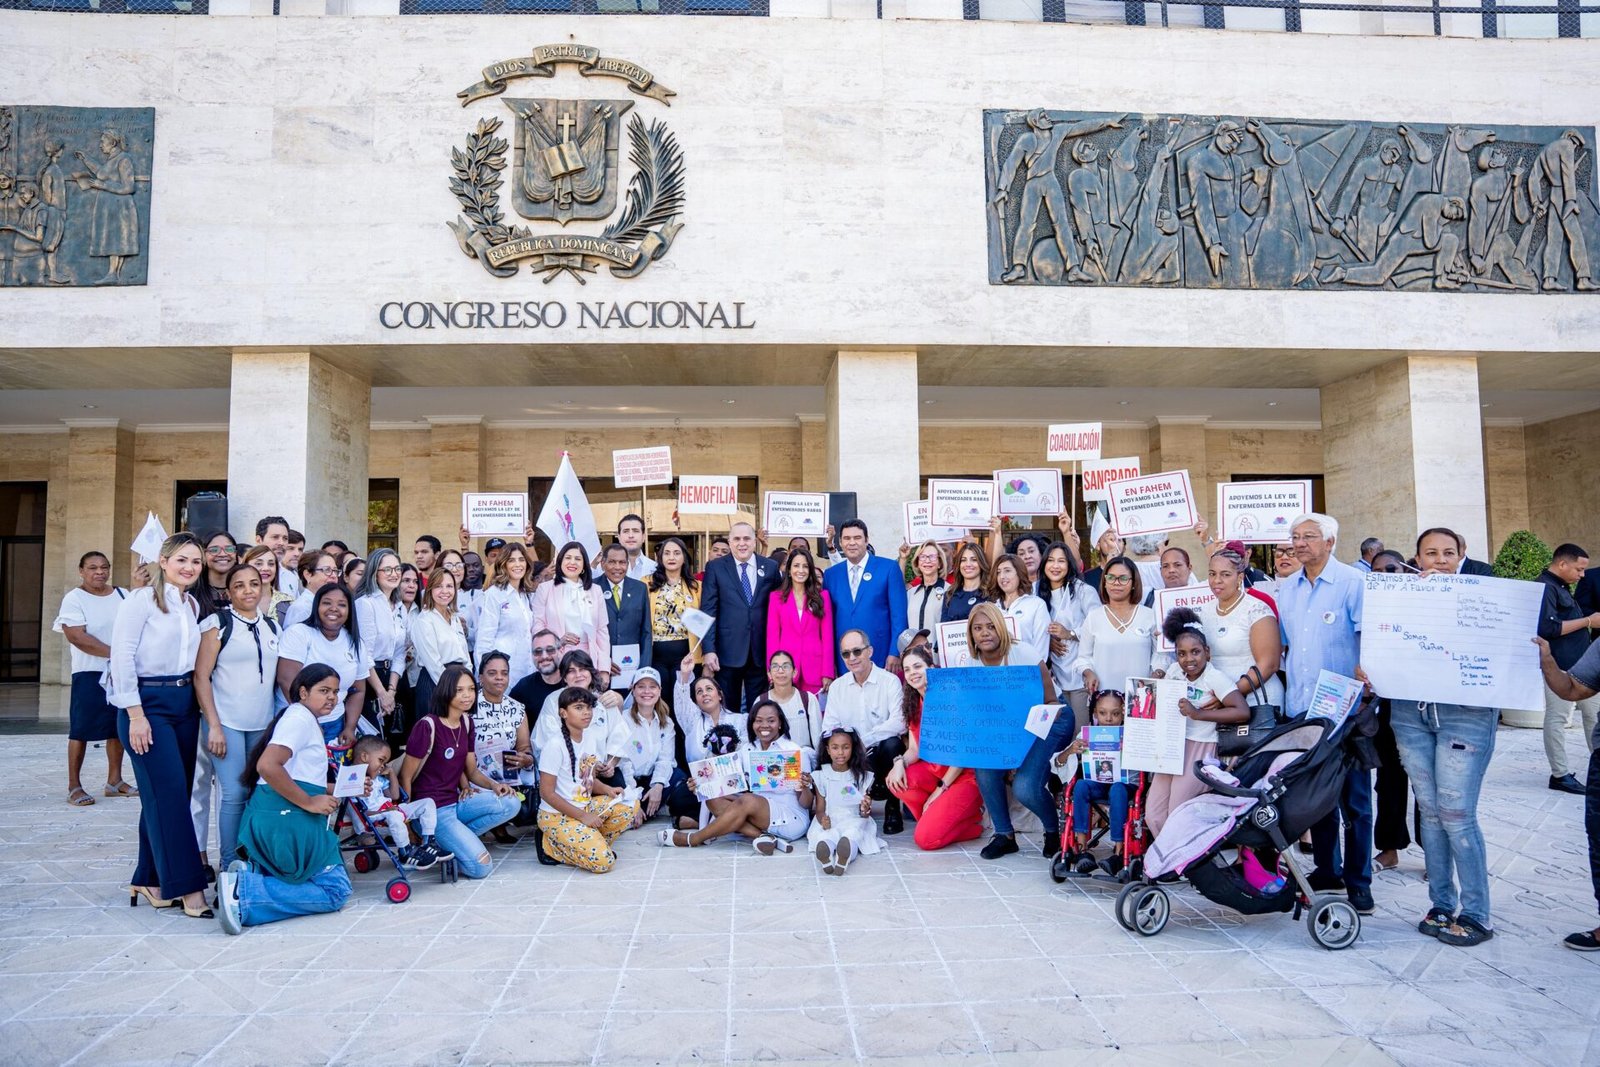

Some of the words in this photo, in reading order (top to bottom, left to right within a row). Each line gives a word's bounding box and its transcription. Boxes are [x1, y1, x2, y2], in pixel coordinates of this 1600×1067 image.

[543, 46, 588, 59] PATRIA
[494, 60, 526, 76] DIOS
[597, 59, 649, 83] LIBERTAD
[490, 240, 554, 262] REPUBLICA
[560, 238, 633, 263] DOMINICANA
[379, 301, 567, 329] CONGRESO
[576, 301, 757, 329] NACIONAL
[1049, 429, 1100, 452] COAGULACIÓN
[680, 485, 736, 504] HEMOFILIA
[1125, 488, 1138, 496] EN
[1140, 482, 1172, 494] FAHEM
[1120, 495, 1152, 504] APOYAMOS
[1120, 501, 1165, 512] ENFERMEDADES
[1175, 597, 1188, 606] EN
